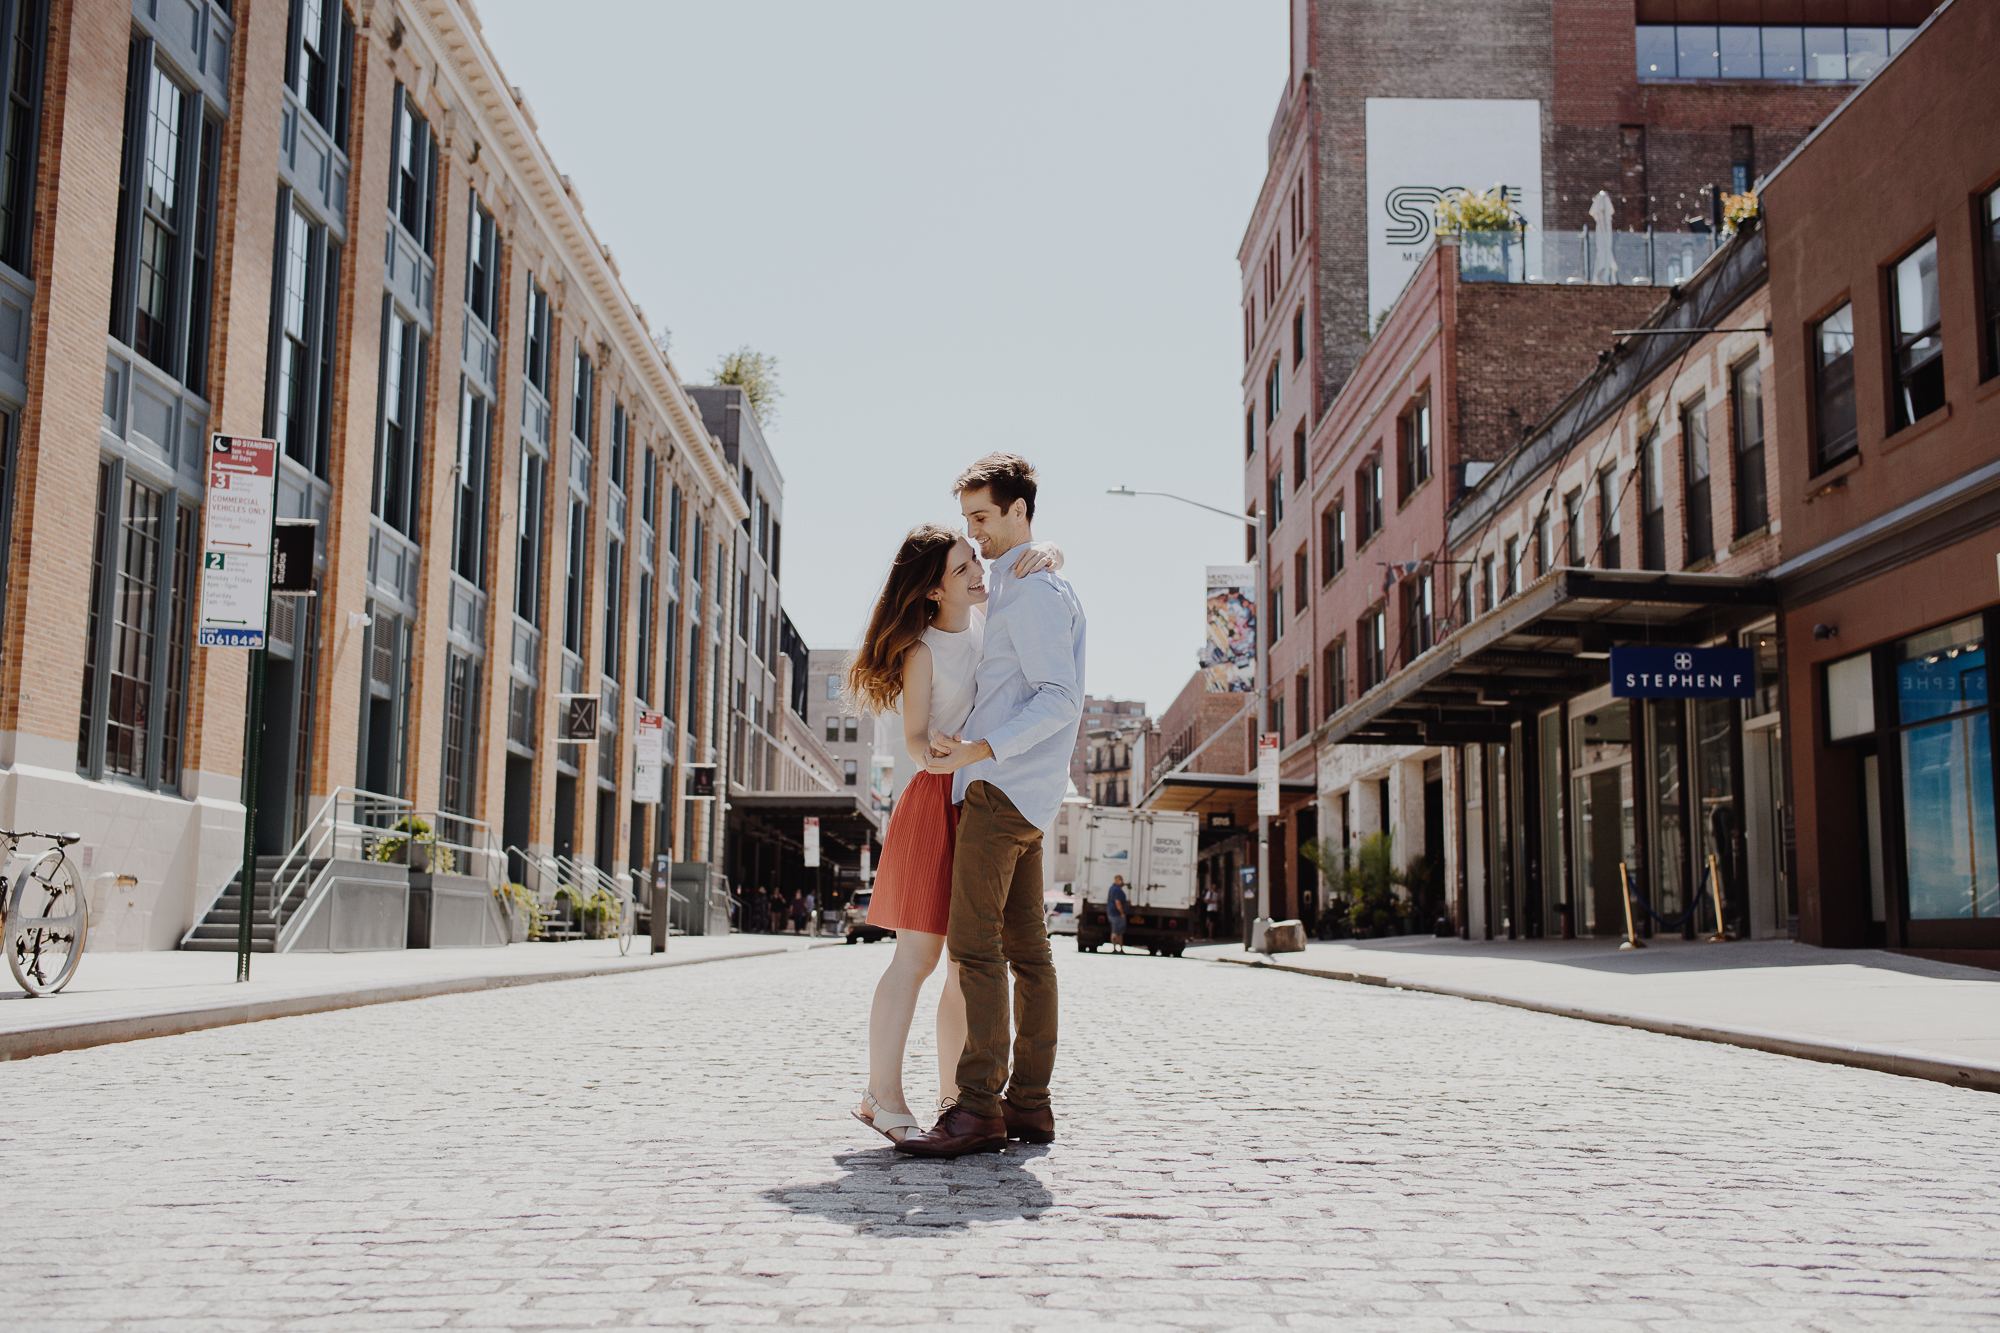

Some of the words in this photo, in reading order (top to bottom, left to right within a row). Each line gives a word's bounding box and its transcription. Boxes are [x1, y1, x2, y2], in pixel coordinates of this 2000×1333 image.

[232, 438, 242, 447] NO
[242, 440, 273, 450] STANDING
[239, 455, 251, 463] Days
[215, 472, 226, 488] 3
[212, 495, 258, 506] COMMERCIAL
[212, 504, 246, 513] VEHICLES
[248, 507, 266, 515] ONLY
[239, 517, 256, 525] Friday
[210, 553, 221, 569] 2
[206, 574, 229, 582] Monday
[206, 591, 232, 599] Saturday
[202, 633, 248, 646] 106184
[1626, 673, 1723, 688] STEPHEN
[1733, 674, 1742, 688] F
